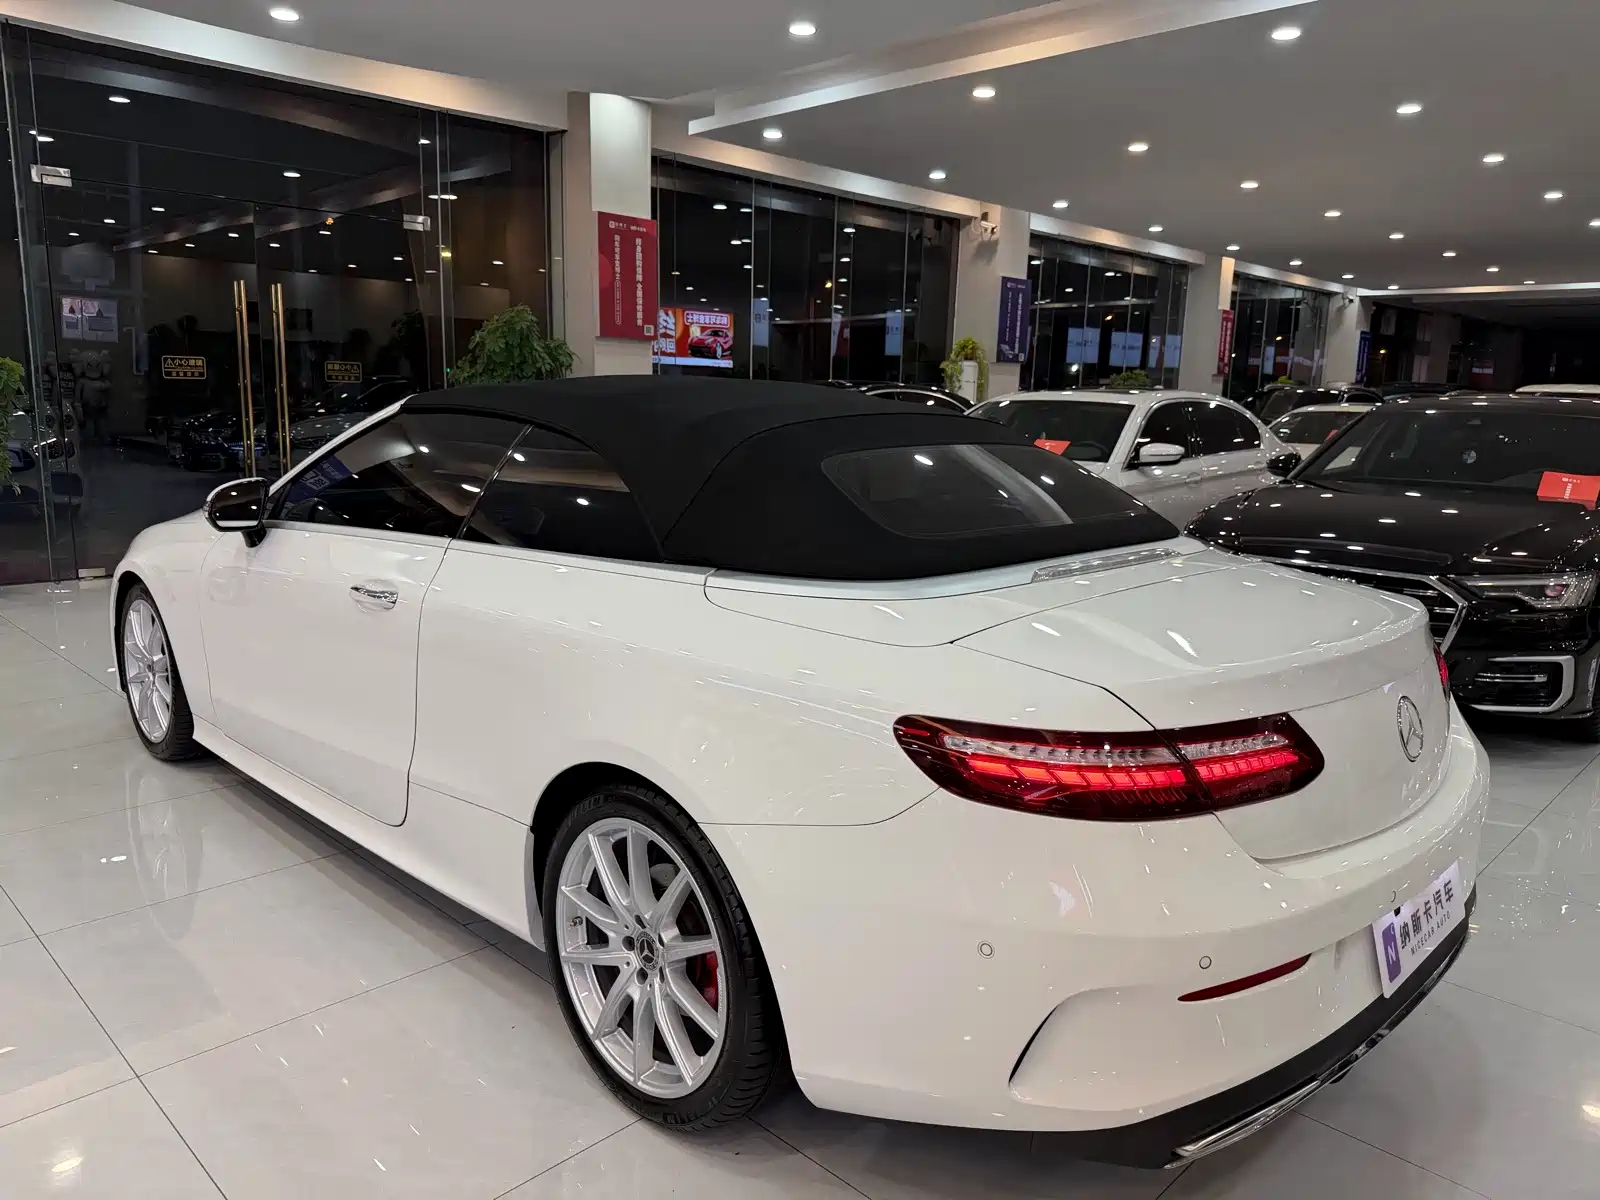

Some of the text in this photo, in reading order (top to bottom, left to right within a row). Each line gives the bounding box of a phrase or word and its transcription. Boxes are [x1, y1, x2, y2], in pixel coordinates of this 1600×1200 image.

[1399, 880, 1454, 950] 纳斯卡汽车
[1410, 910, 1451, 957] NICECAR AUTO
